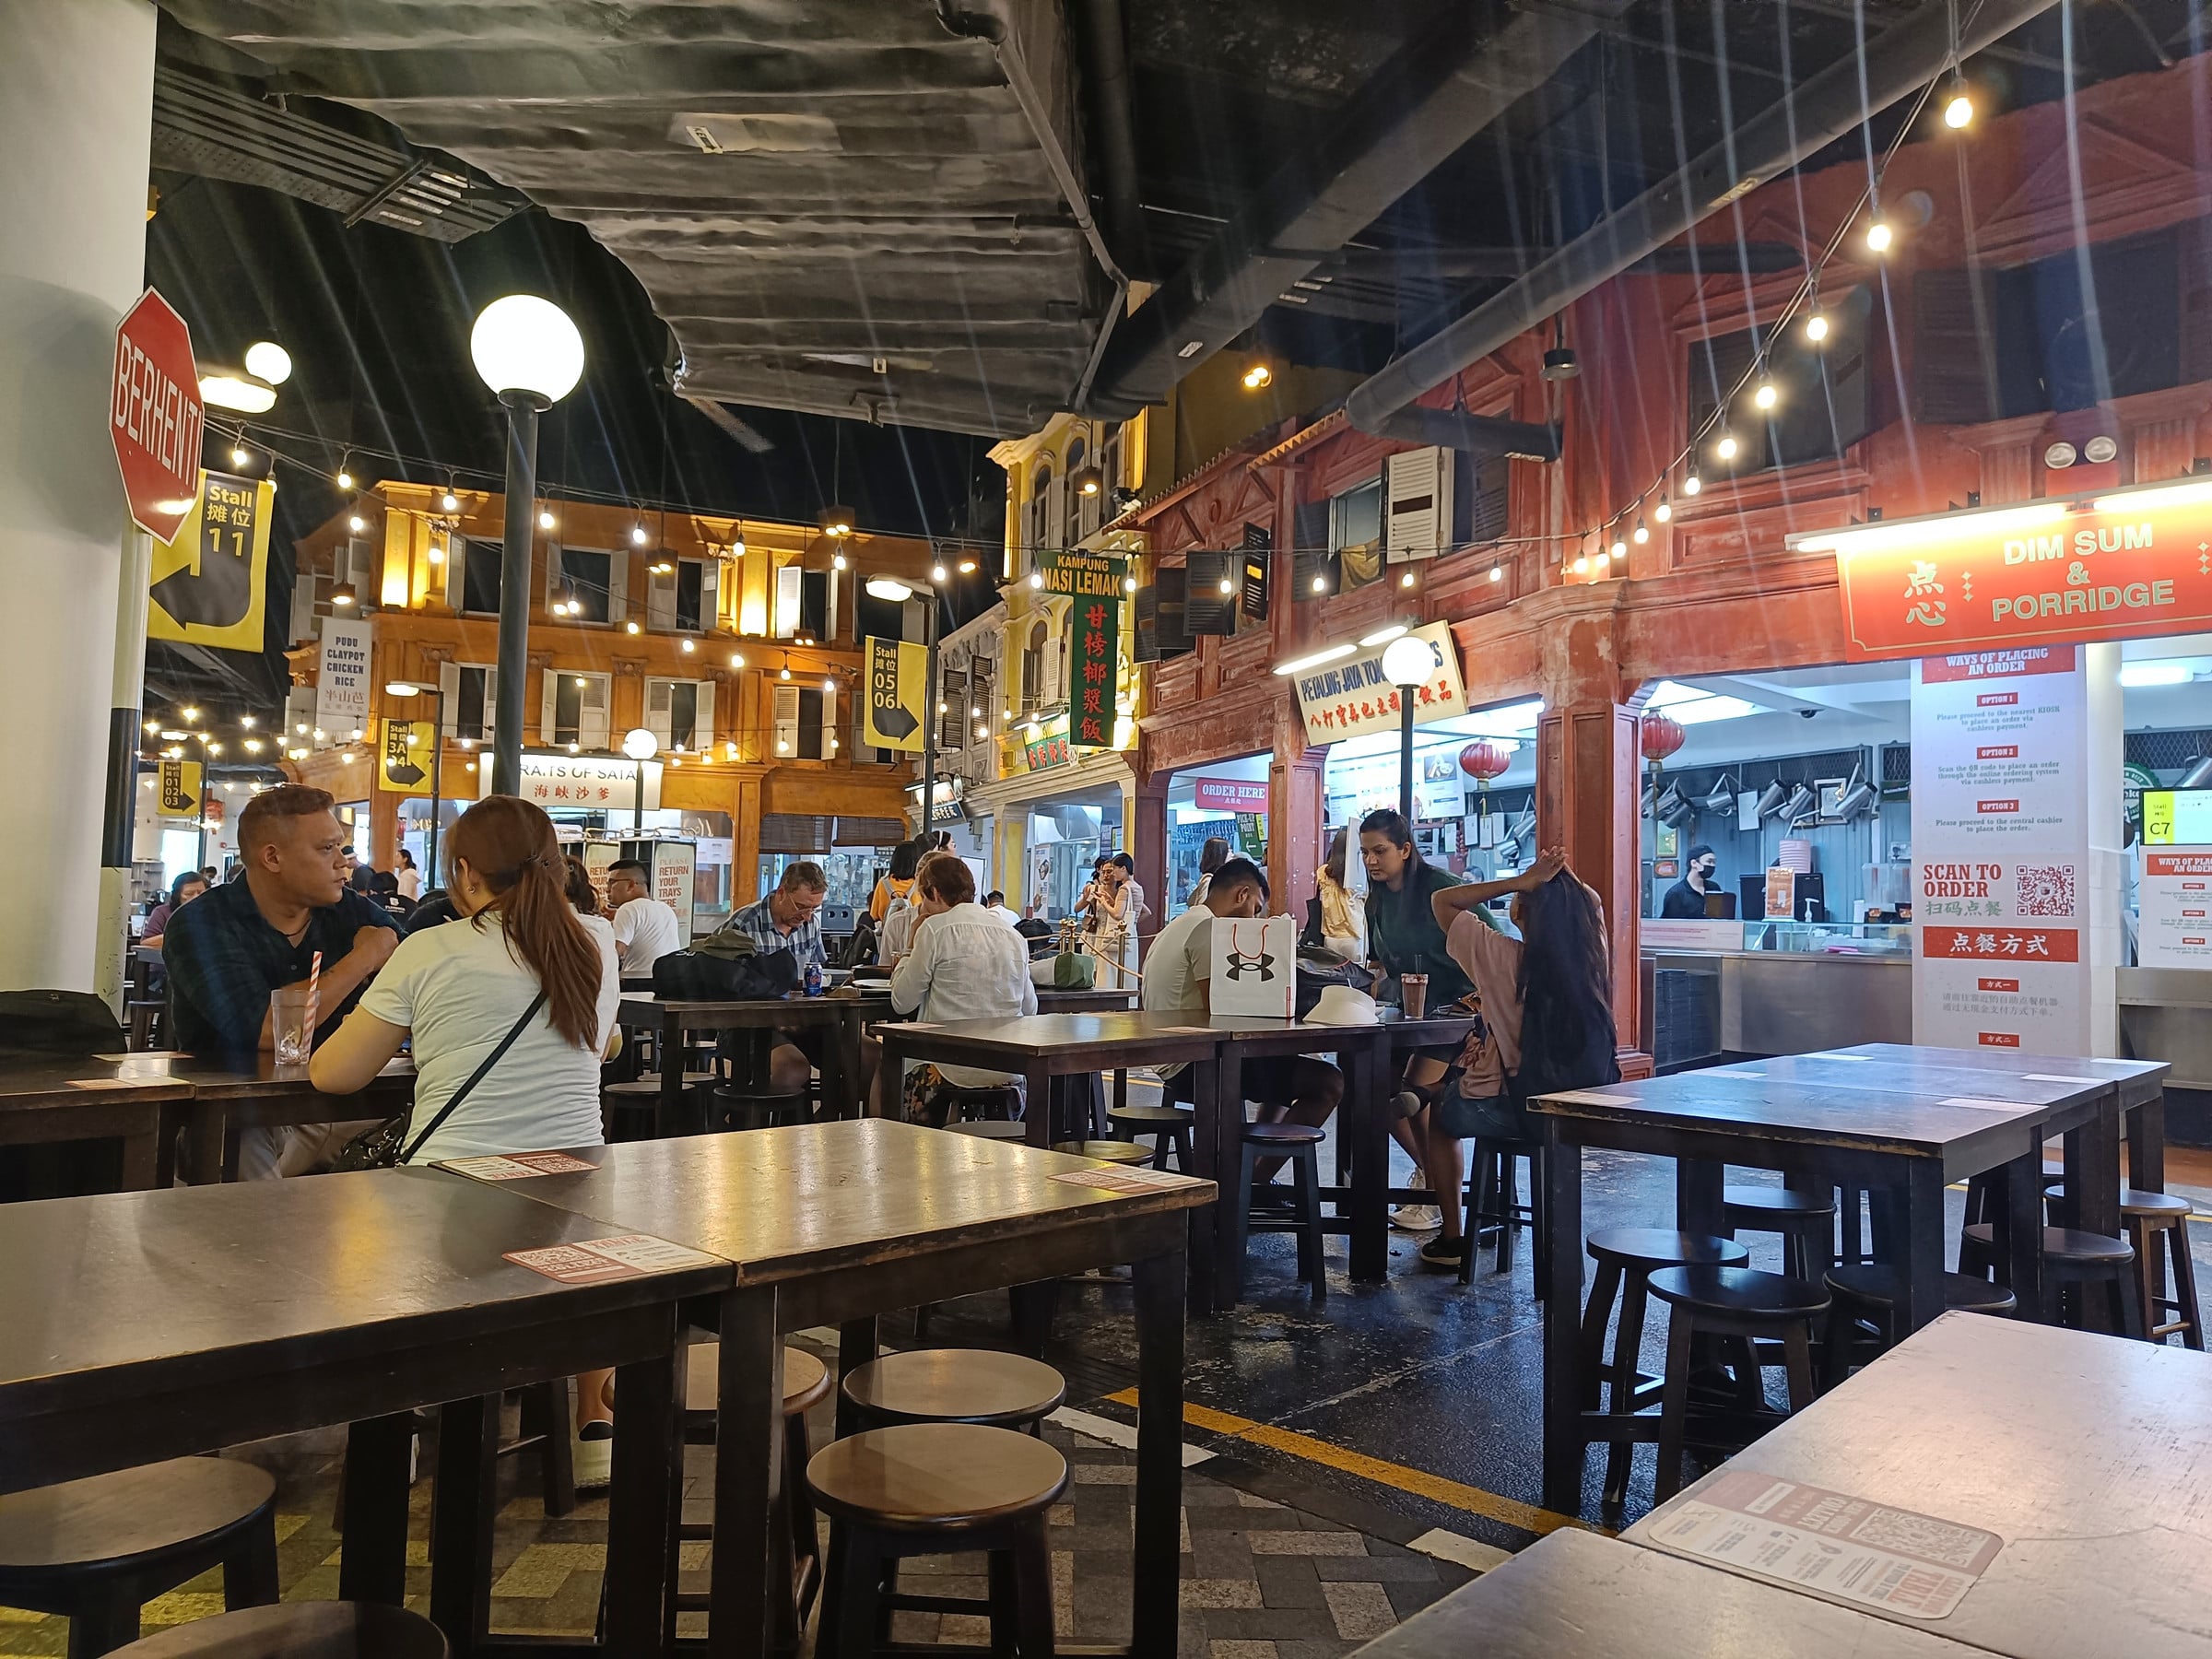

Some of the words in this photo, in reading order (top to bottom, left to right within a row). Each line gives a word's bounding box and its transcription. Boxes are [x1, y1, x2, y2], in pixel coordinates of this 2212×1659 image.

[115, 333, 202, 491] BERHENTI
[209, 486, 253, 508] Stall
[206, 502, 251, 527] 摊位
[209, 527, 243, 557] 11
[2003, 535, 2065, 565] DIM
[2074, 523, 2153, 557] SUM
[1057, 555, 1109, 571] KAMPUNG
[2066, 560, 2091, 585] &
[1042, 568, 1072, 592] NASI
[1077, 571, 1121, 597] LEMAK
[1904, 559, 1947, 627] 点心
[1992, 579, 2175, 622] PORRIDGE
[335, 636, 359, 647] PUDU
[327, 649, 365, 661] CLAYPOT
[876, 646, 896, 659] Stall
[1947, 654, 1977, 666] WAYS
[1980, 653, 1995, 664] OF
[1998, 648, 2048, 663] PLACING
[326, 662, 364, 675] CHICKEN
[1968, 664, 1983, 676] AN
[1986, 661, 2025, 674] ORDER
[335, 676, 355, 687] RICE
[875, 673, 895, 690] 05
[1300, 670, 1343, 702] PETALING
[1342, 662, 1363, 692] JAYA
[1361, 655, 1387, 686] TOA
[875, 691, 896, 710] 06
[1982, 696, 2007, 704] OPTION
[1959, 711, 1985, 722] proceed
[1971, 718, 1988, 727] place
[388, 741, 406, 754] 3A
[1982, 748, 2007, 757] OPTION
[1969, 764, 1978, 772] QR
[2007, 761, 2026, 771] place
[1938, 772, 1964, 781] through
[2003, 769, 2033, 778] ordering
[2035, 768, 2059, 776] system
[166, 778, 178, 786] 01
[166, 787, 179, 796] 02
[1202, 784, 1235, 797] ORDER
[1238, 786, 1265, 799] HERE
[165, 796, 178, 806] 03
[1240, 823, 1254, 832] POINT
[1959, 818, 1984, 827] proceed
[2037, 816, 2063, 824] cashier
[2150, 822, 2170, 835] C7
[590, 867, 608, 876] RETU
[659, 865, 689, 877] RETURN
[1924, 864, 1971, 880] SCAN
[1976, 865, 2002, 880] TO
[659, 877, 678, 887] YOUR
[658, 888, 682, 898] TRAYS
[1924, 881, 1989, 898] ORDER
[1925, 900, 2003, 917] 扫码点餐
[1950, 932, 2049, 956] 点餐方式
